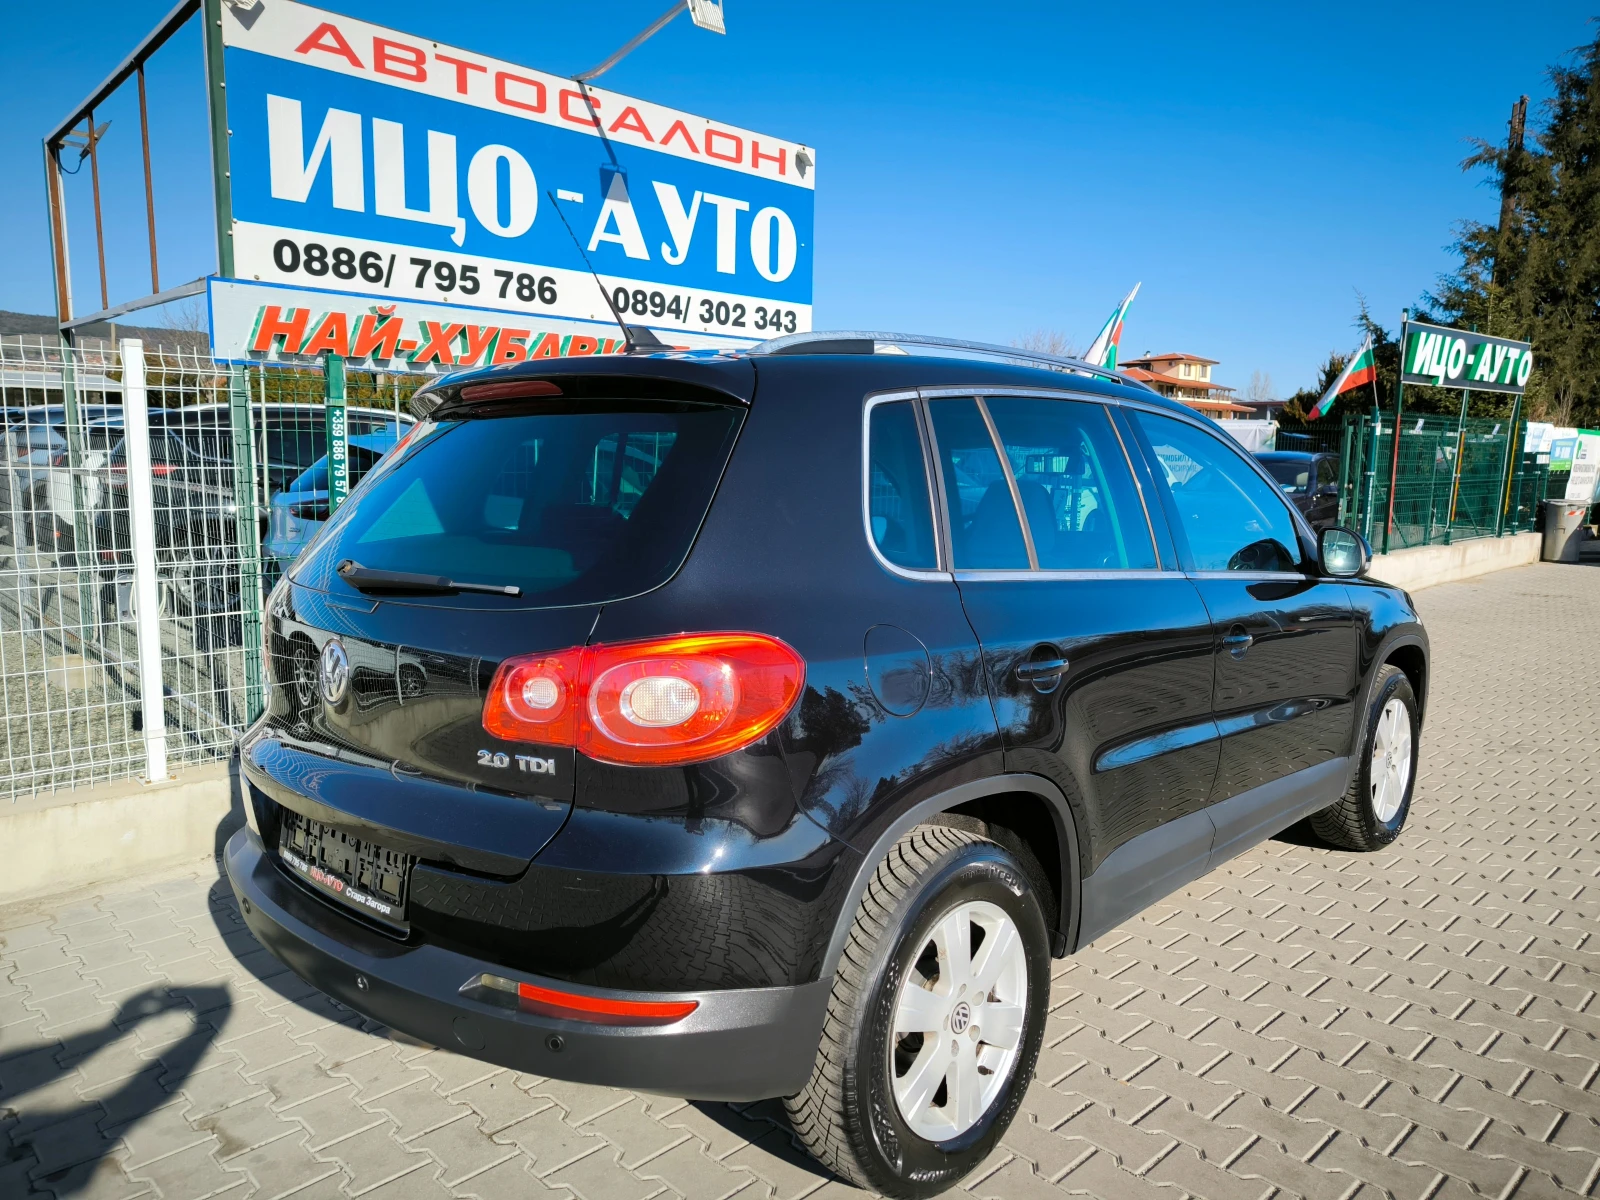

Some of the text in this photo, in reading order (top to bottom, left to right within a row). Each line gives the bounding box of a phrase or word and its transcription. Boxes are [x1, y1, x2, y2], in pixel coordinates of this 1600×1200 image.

[294, 21, 787, 176] АВТОСАЛОН
[273, 238, 558, 305] 0886/ 795 786
[612, 286, 797, 334] 0894/ 302 343
[1411, 331, 1534, 386] ИЦО-АУТО
[332, 409, 344, 437] +359
[332, 439, 345, 461] 886
[333, 463, 346, 477] 79
[334, 480, 347, 493] 57
[514, 754, 556, 776] TDI
[345, 887, 365, 903] Стара
[365, 896, 392, 915] Загора
